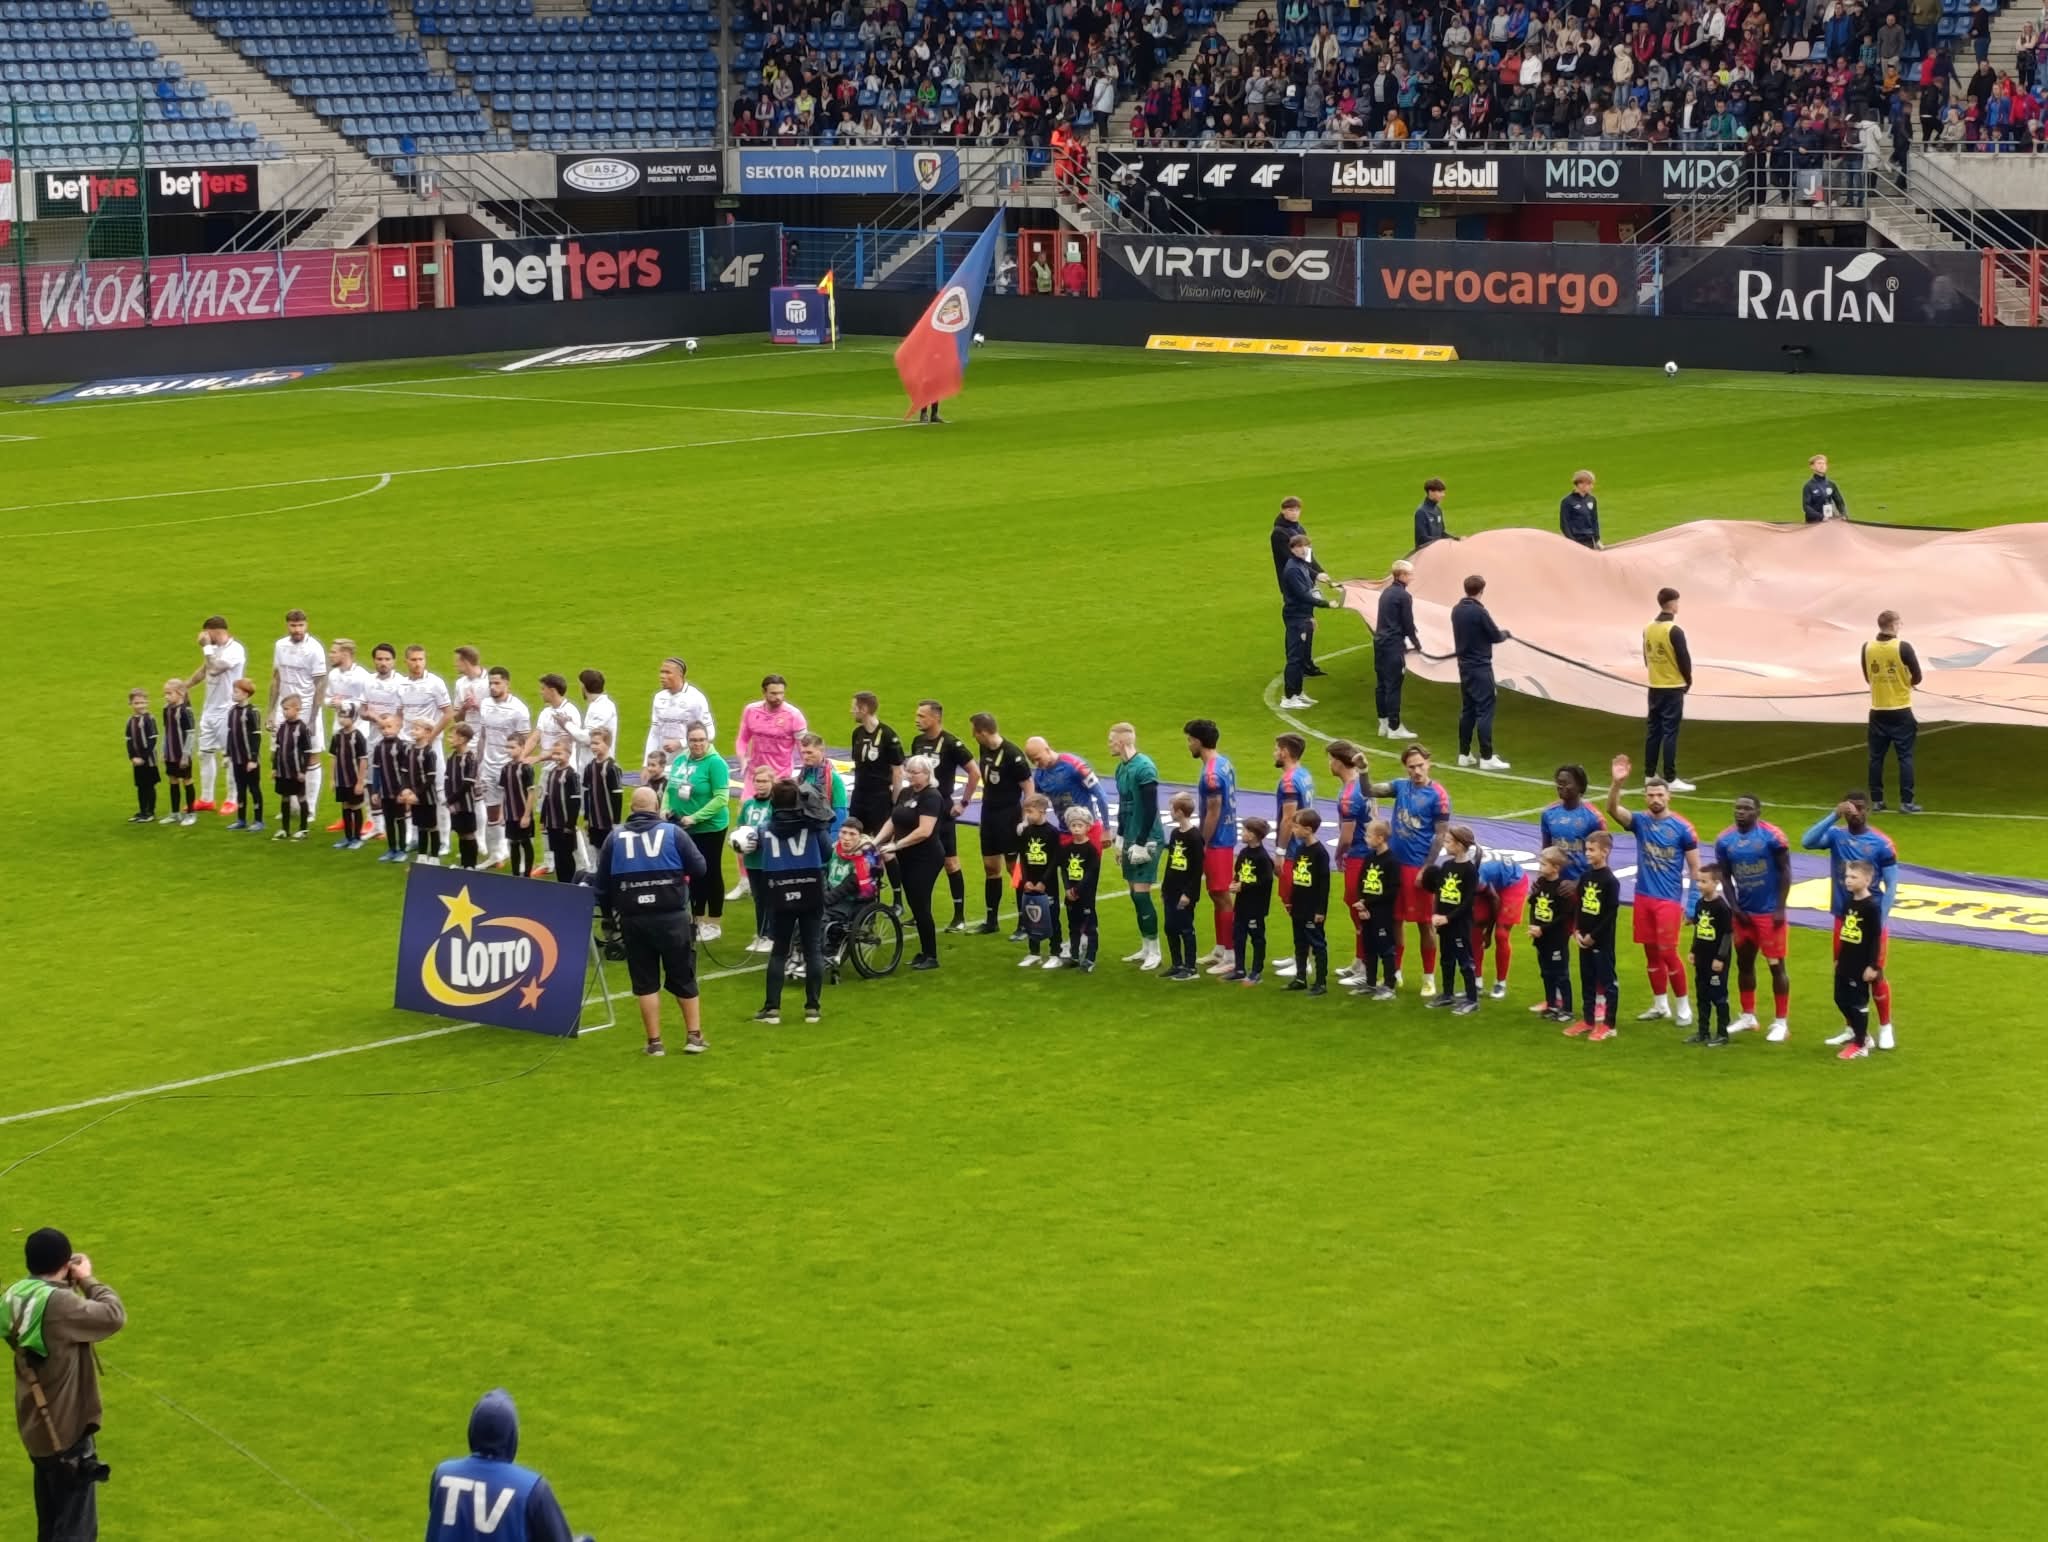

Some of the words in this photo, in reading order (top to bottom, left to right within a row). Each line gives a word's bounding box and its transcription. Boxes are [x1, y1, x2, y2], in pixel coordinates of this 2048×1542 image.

[647, 165, 692, 175] MASZYNY
[698, 164, 717, 174] DLA
[745, 165, 805, 179] SEKTOR
[809, 164, 887, 179] RODZINNY
[1157, 163, 1190, 187] 4F
[1202, 163, 1237, 187] 4F
[1250, 164, 1285, 188] 4F
[47, 174, 138, 214] betters
[159, 170, 248, 210] betters
[421, 175, 433, 194] H
[1803, 175, 1816, 196] J
[480, 241, 662, 301] betters
[719, 253, 765, 288] 4F
[1123, 244, 1331, 281] VIRTU-OS
[1179, 284, 1209, 298] Vision
[1211, 285, 1231, 299] into
[1233, 286, 1267, 301] reality
[1380, 266, 1619, 314] verocargo
[776, 328, 796, 336] Bank
[617, 827, 665, 859] TV
[450, 936, 532, 988] LOTTO
[439, 1474, 516, 1534] TV
